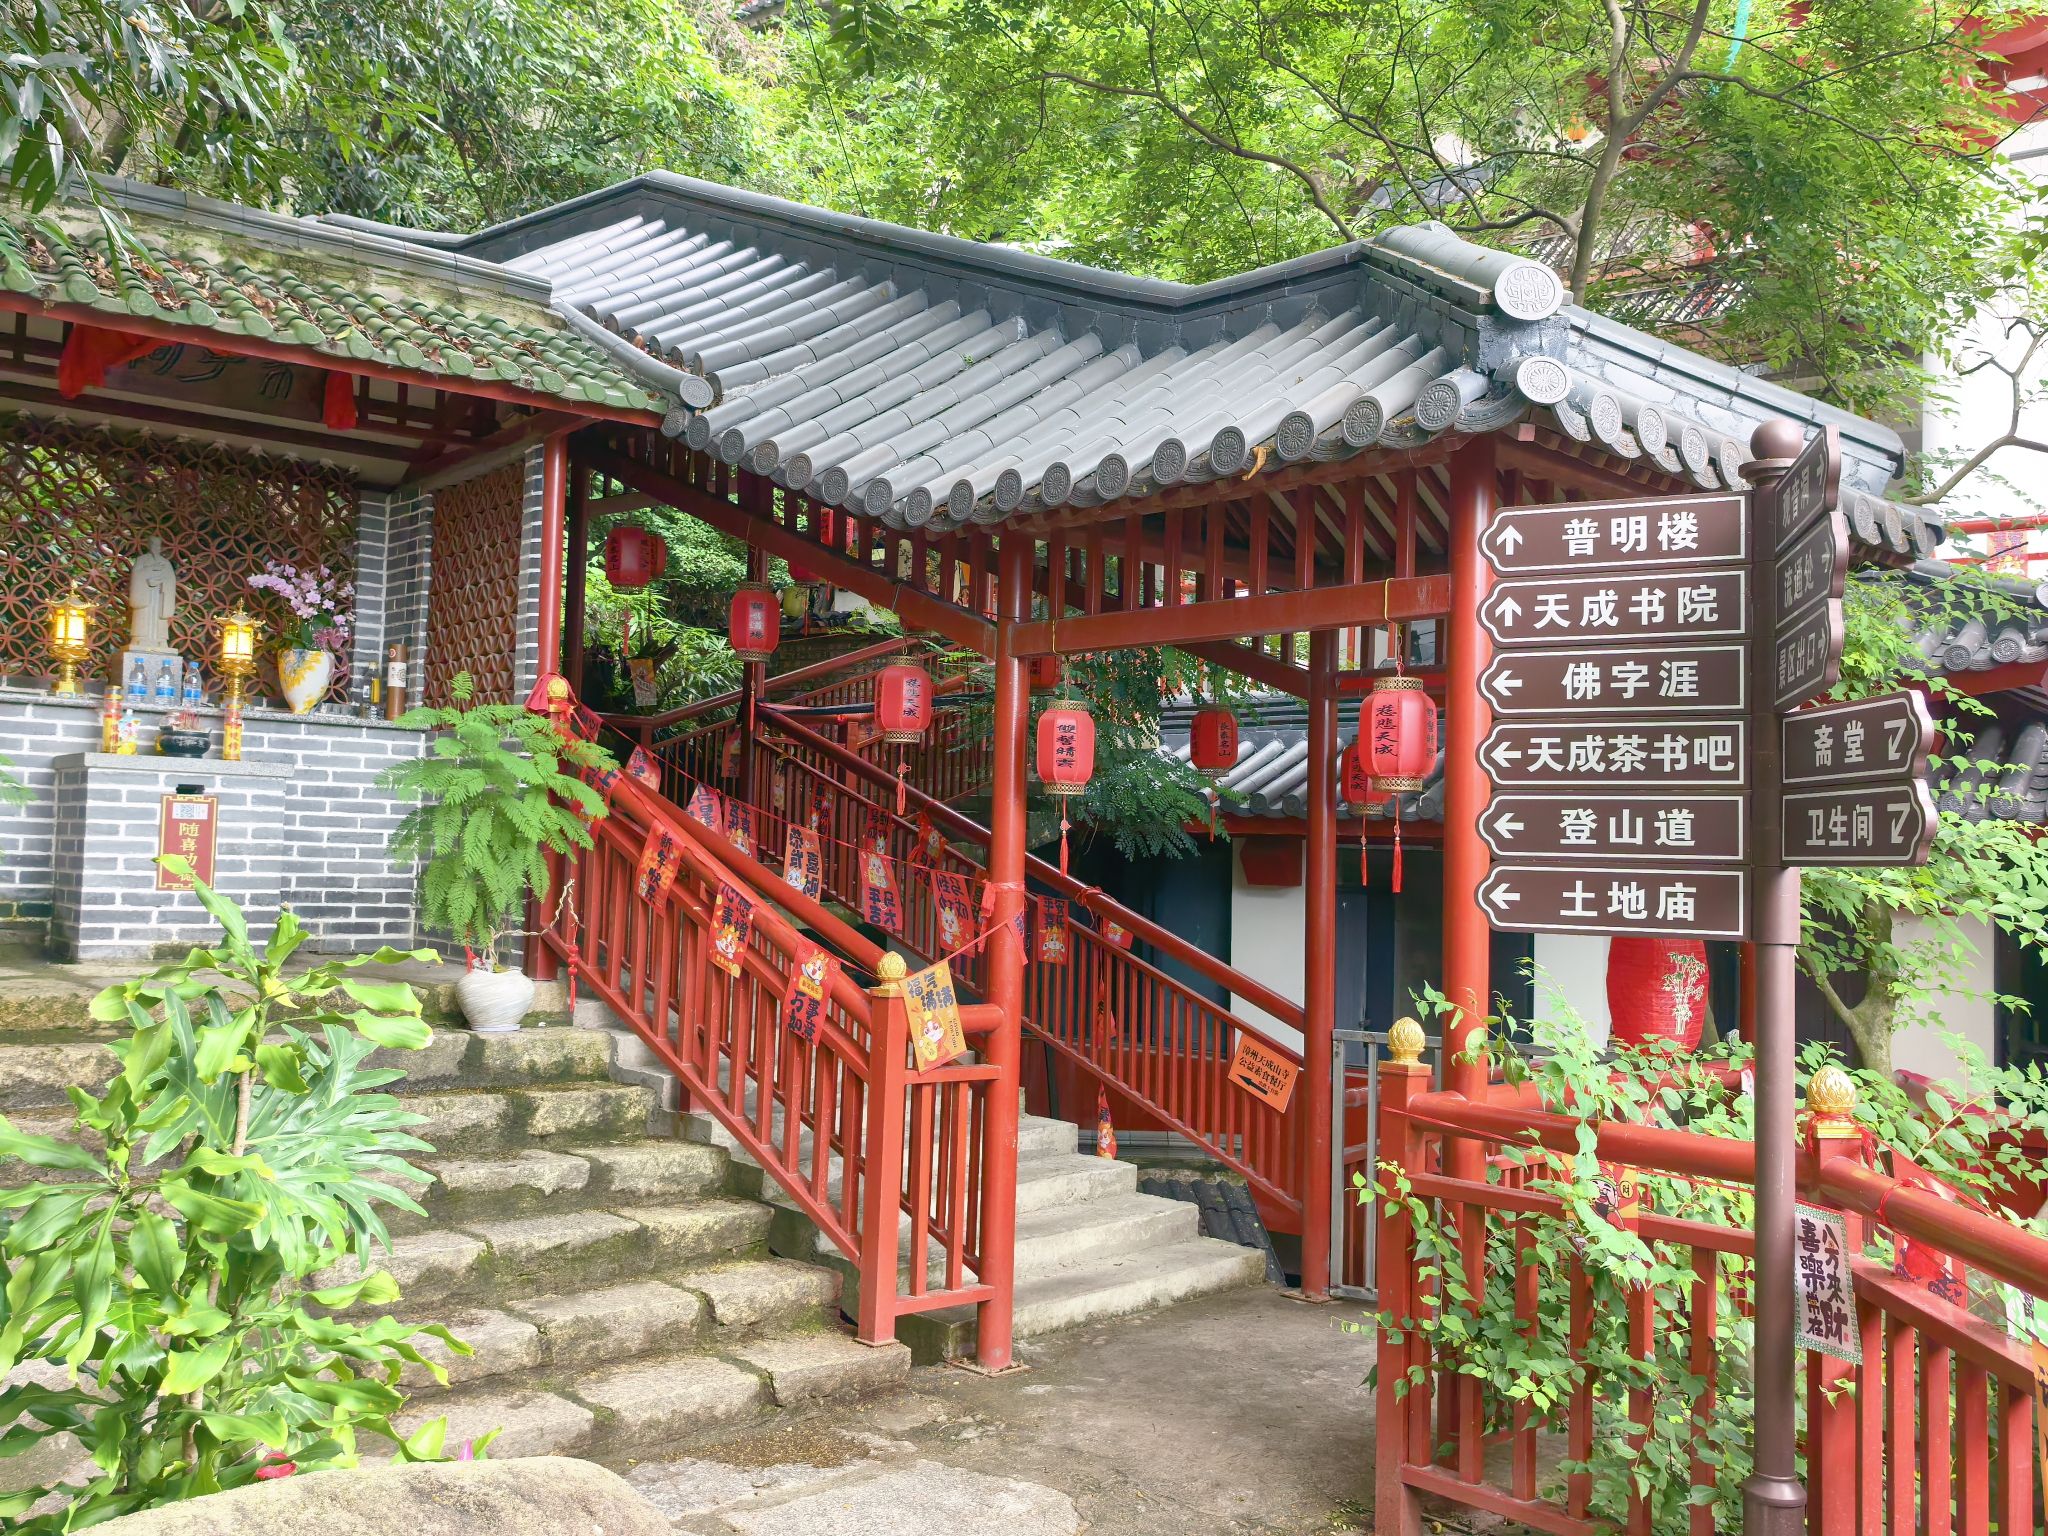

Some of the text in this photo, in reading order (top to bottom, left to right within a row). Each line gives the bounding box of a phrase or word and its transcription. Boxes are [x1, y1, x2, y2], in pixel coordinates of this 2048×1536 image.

[1562, 512, 1700, 557] 普明楼
[1784, 554, 1814, 608] 流通处
[1533, 585, 1720, 629] 天成书院
[1561, 661, 1699, 699] 佛字涯
[1778, 631, 1816, 690] 景区出口
[1527, 734, 1735, 773] 天成茶书吧
[1814, 720, 1865, 767] 斋堂
[1559, 808, 1696, 847] 登山道
[1807, 804, 1873, 847] 卫生间
[1560, 882, 1697, 922] 土地庙
